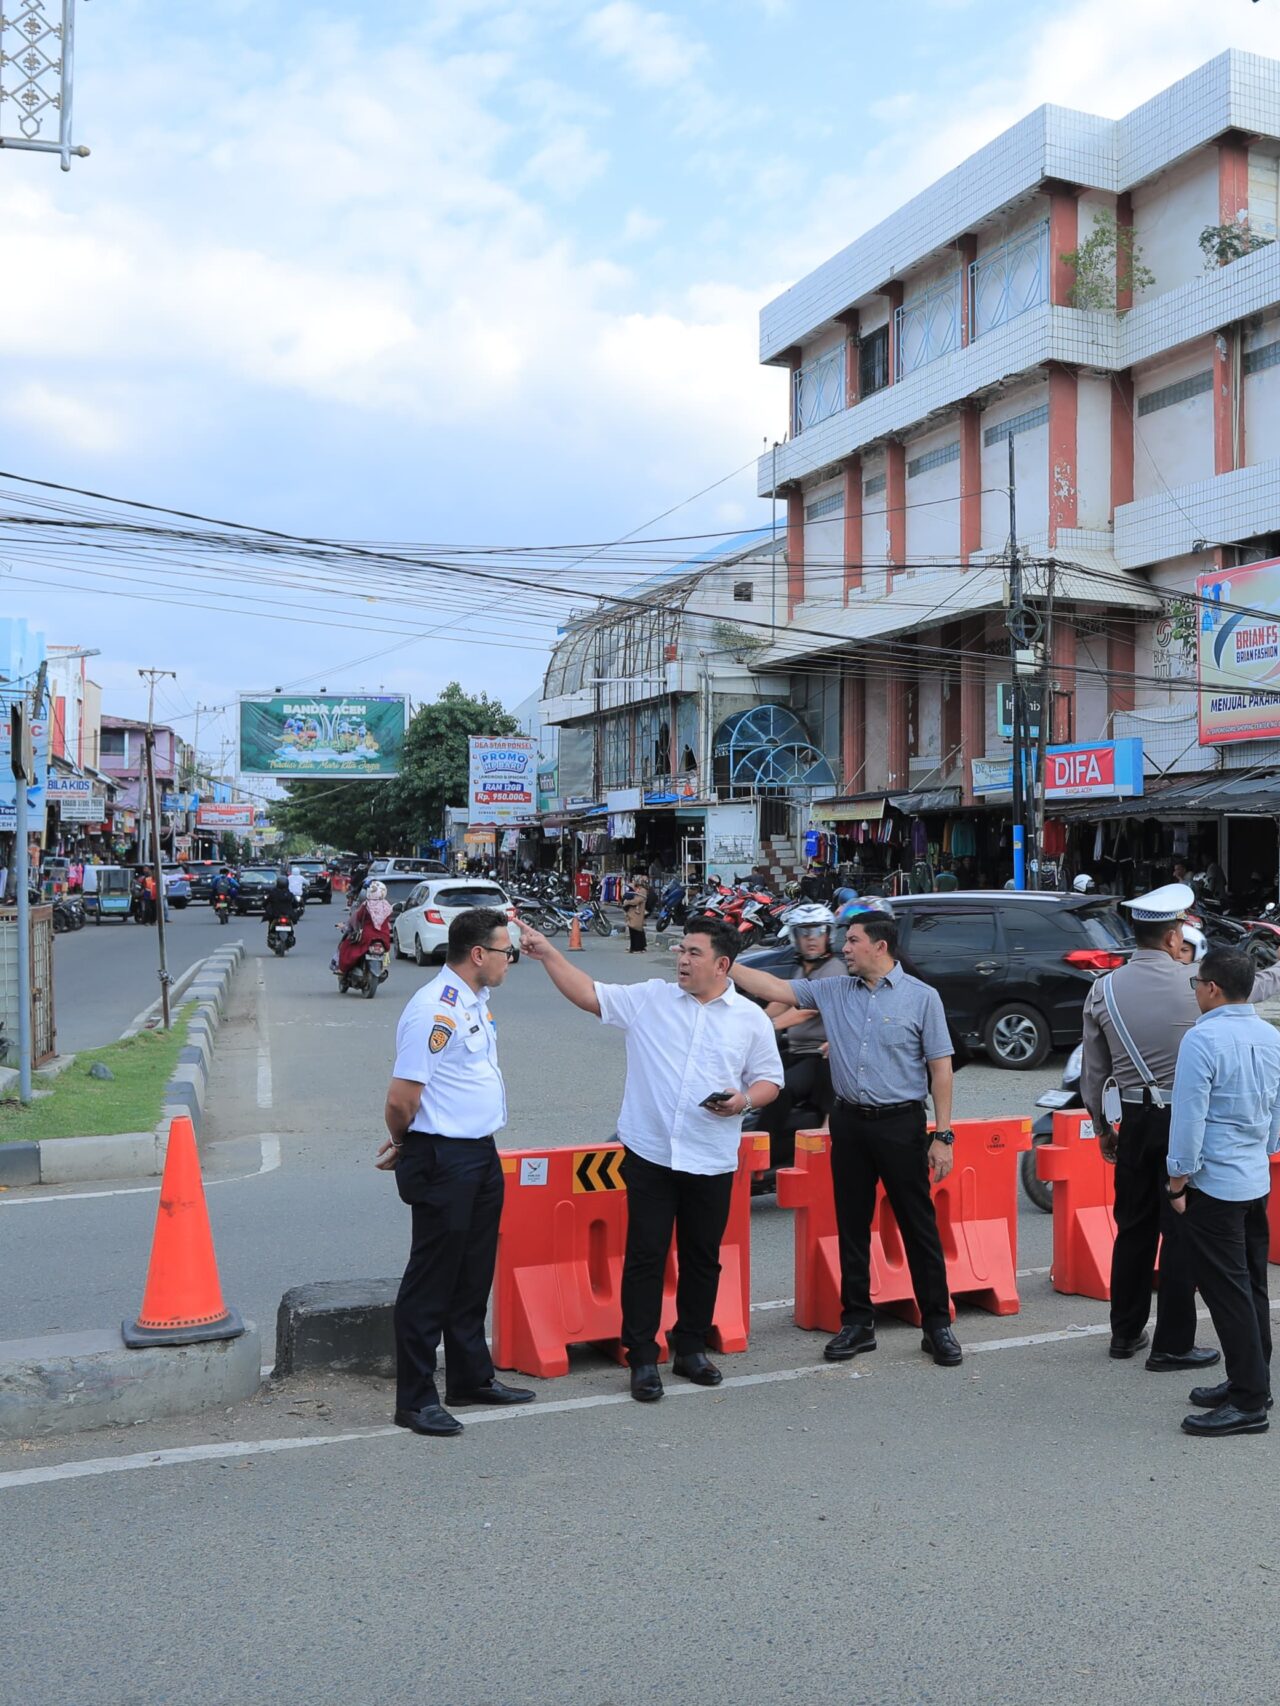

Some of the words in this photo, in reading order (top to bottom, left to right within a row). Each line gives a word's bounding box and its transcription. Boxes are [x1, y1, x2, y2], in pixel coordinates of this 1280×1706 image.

[1236, 629, 1264, 650] BRIAN
[1266, 624, 1278, 644] FS
[1236, 649, 1254, 663] BRIAN
[1254, 645, 1278, 660] FASHION
[283, 704, 329, 714] BANDA
[331, 704, 366, 714] ACEH
[1210, 695, 1247, 713] MENJUAL
[482, 752, 525, 762] PROMO
[1055, 754, 1102, 786] DIFA
[47, 781, 69, 790] BILA
[69, 781, 90, 790] KIDS
